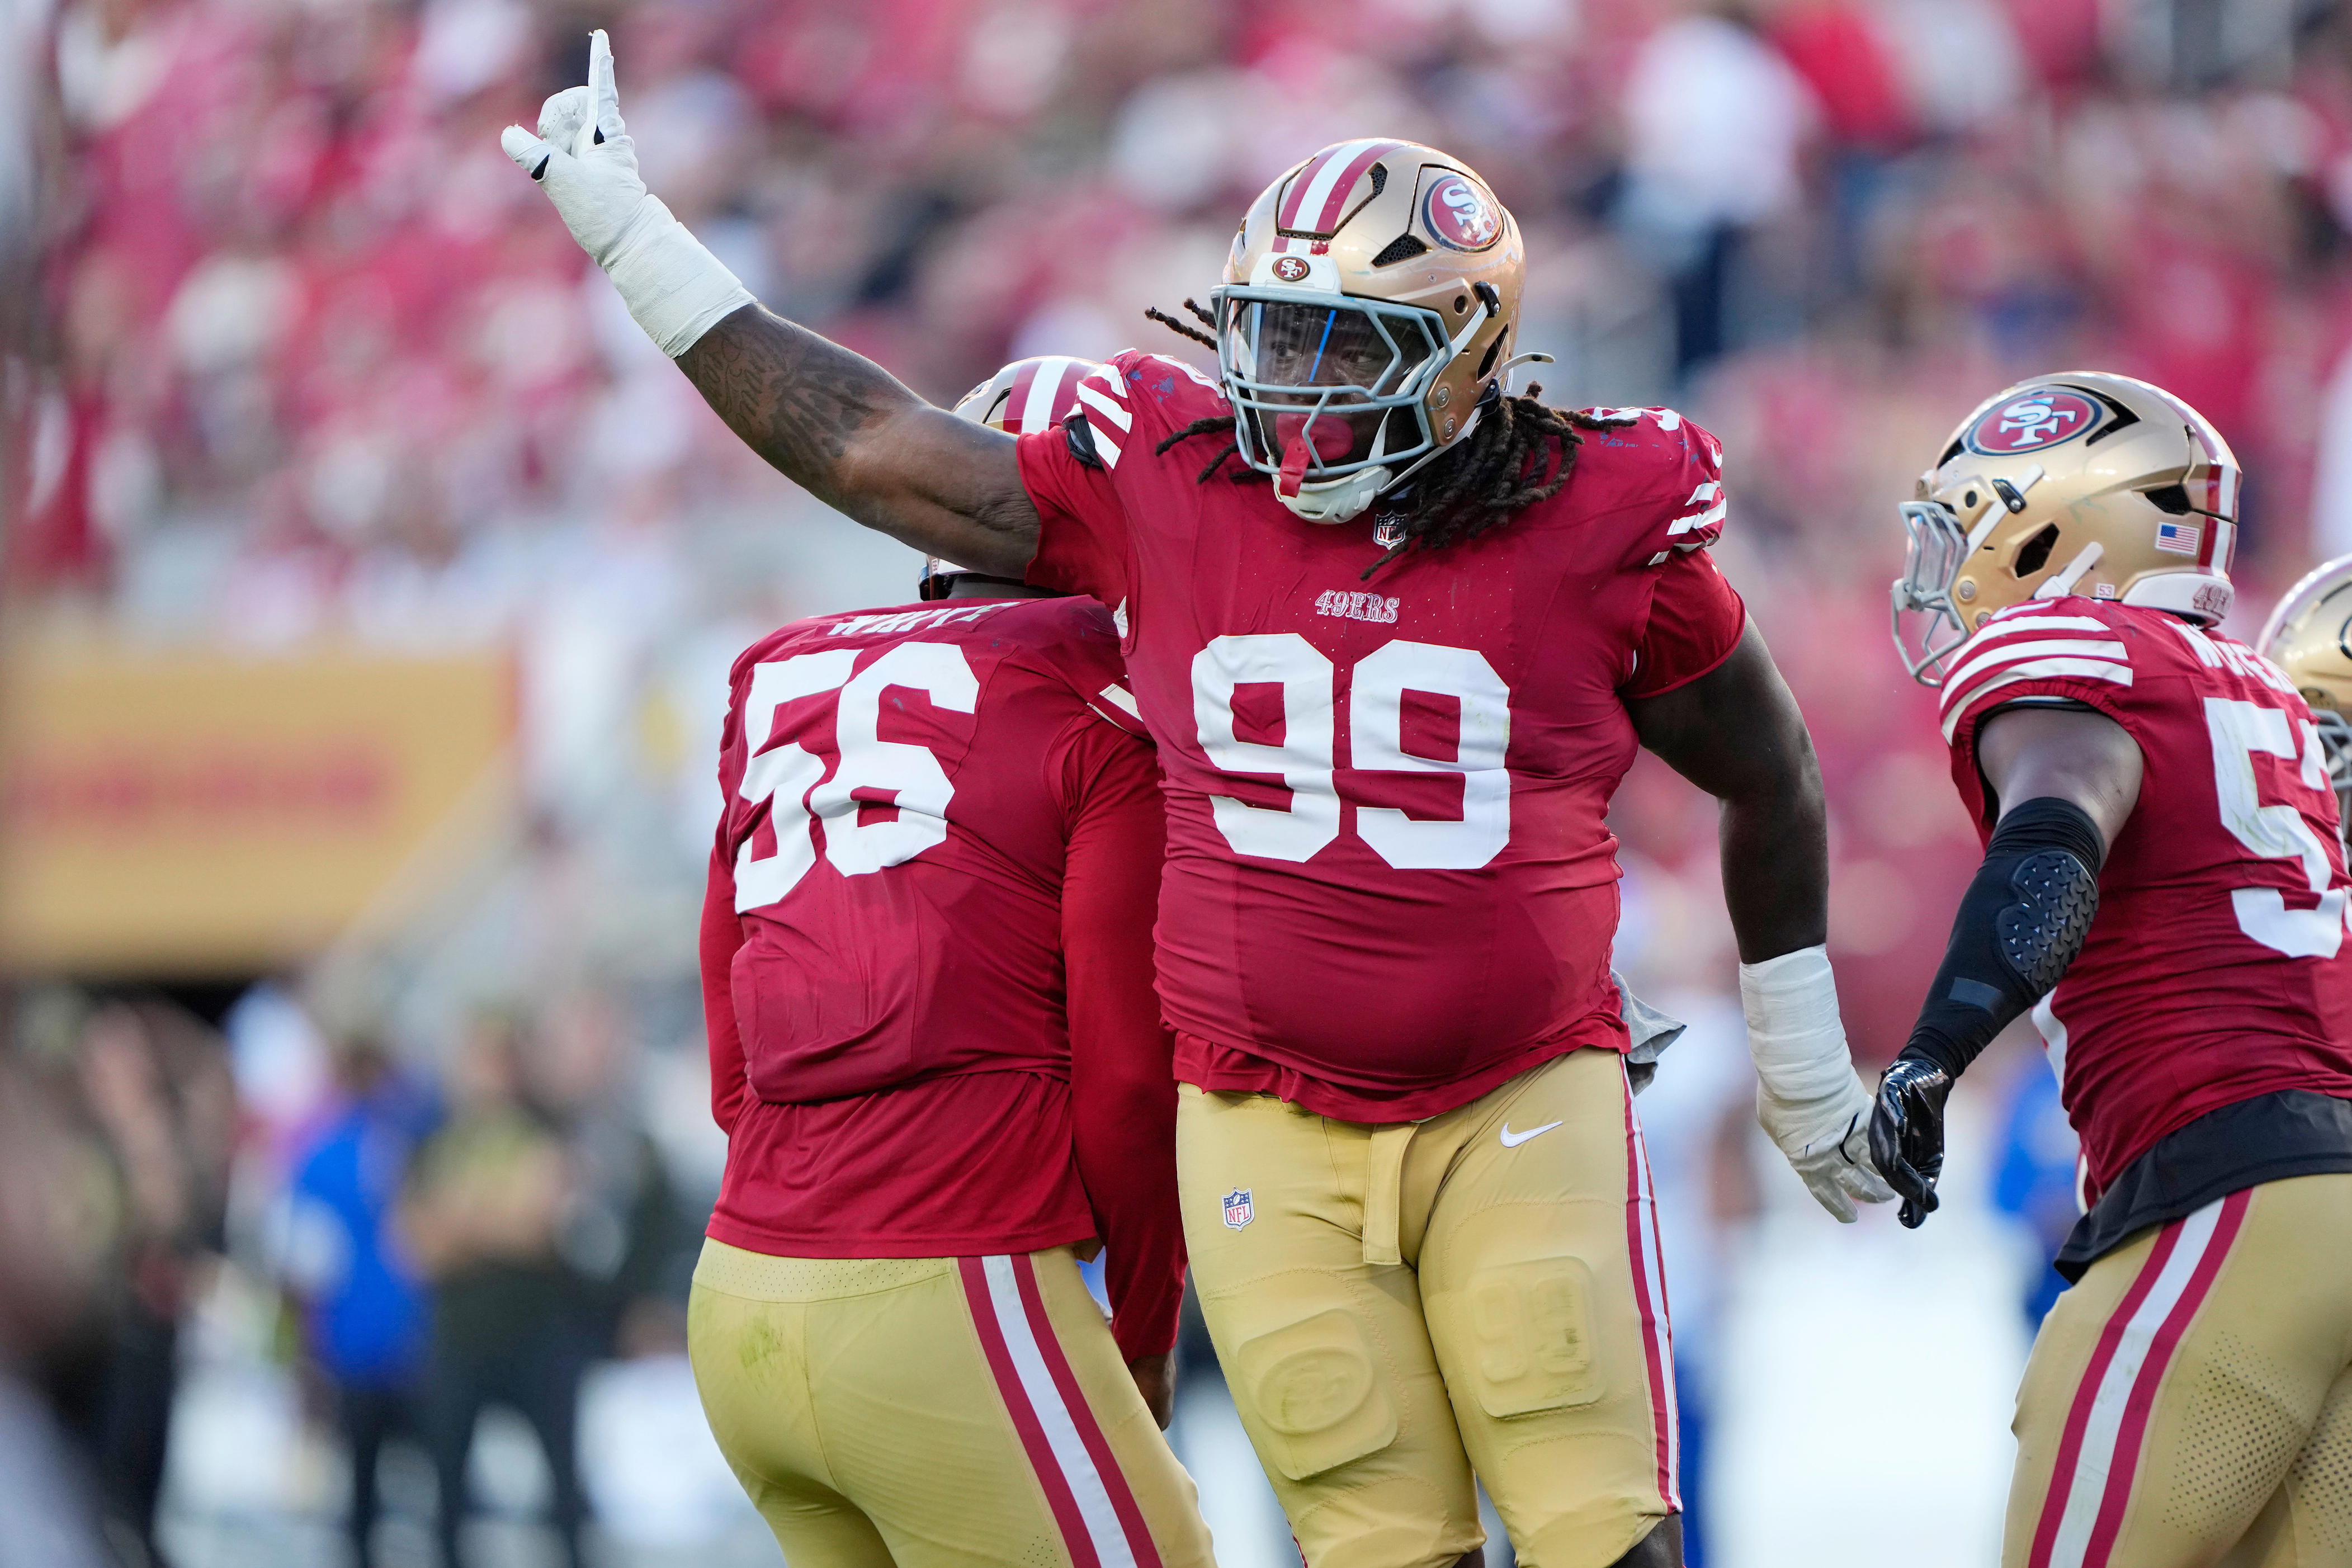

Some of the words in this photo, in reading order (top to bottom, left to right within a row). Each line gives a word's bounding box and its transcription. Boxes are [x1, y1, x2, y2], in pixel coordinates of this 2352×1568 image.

[1281, 258, 1302, 278] SF
[1999, 396, 2077, 447] SF
[1315, 589, 1400, 625] 49ERS
[1191, 632, 1510, 870] 99
[734, 641, 980, 915] 56
[1227, 1206, 1249, 1223] NFL
